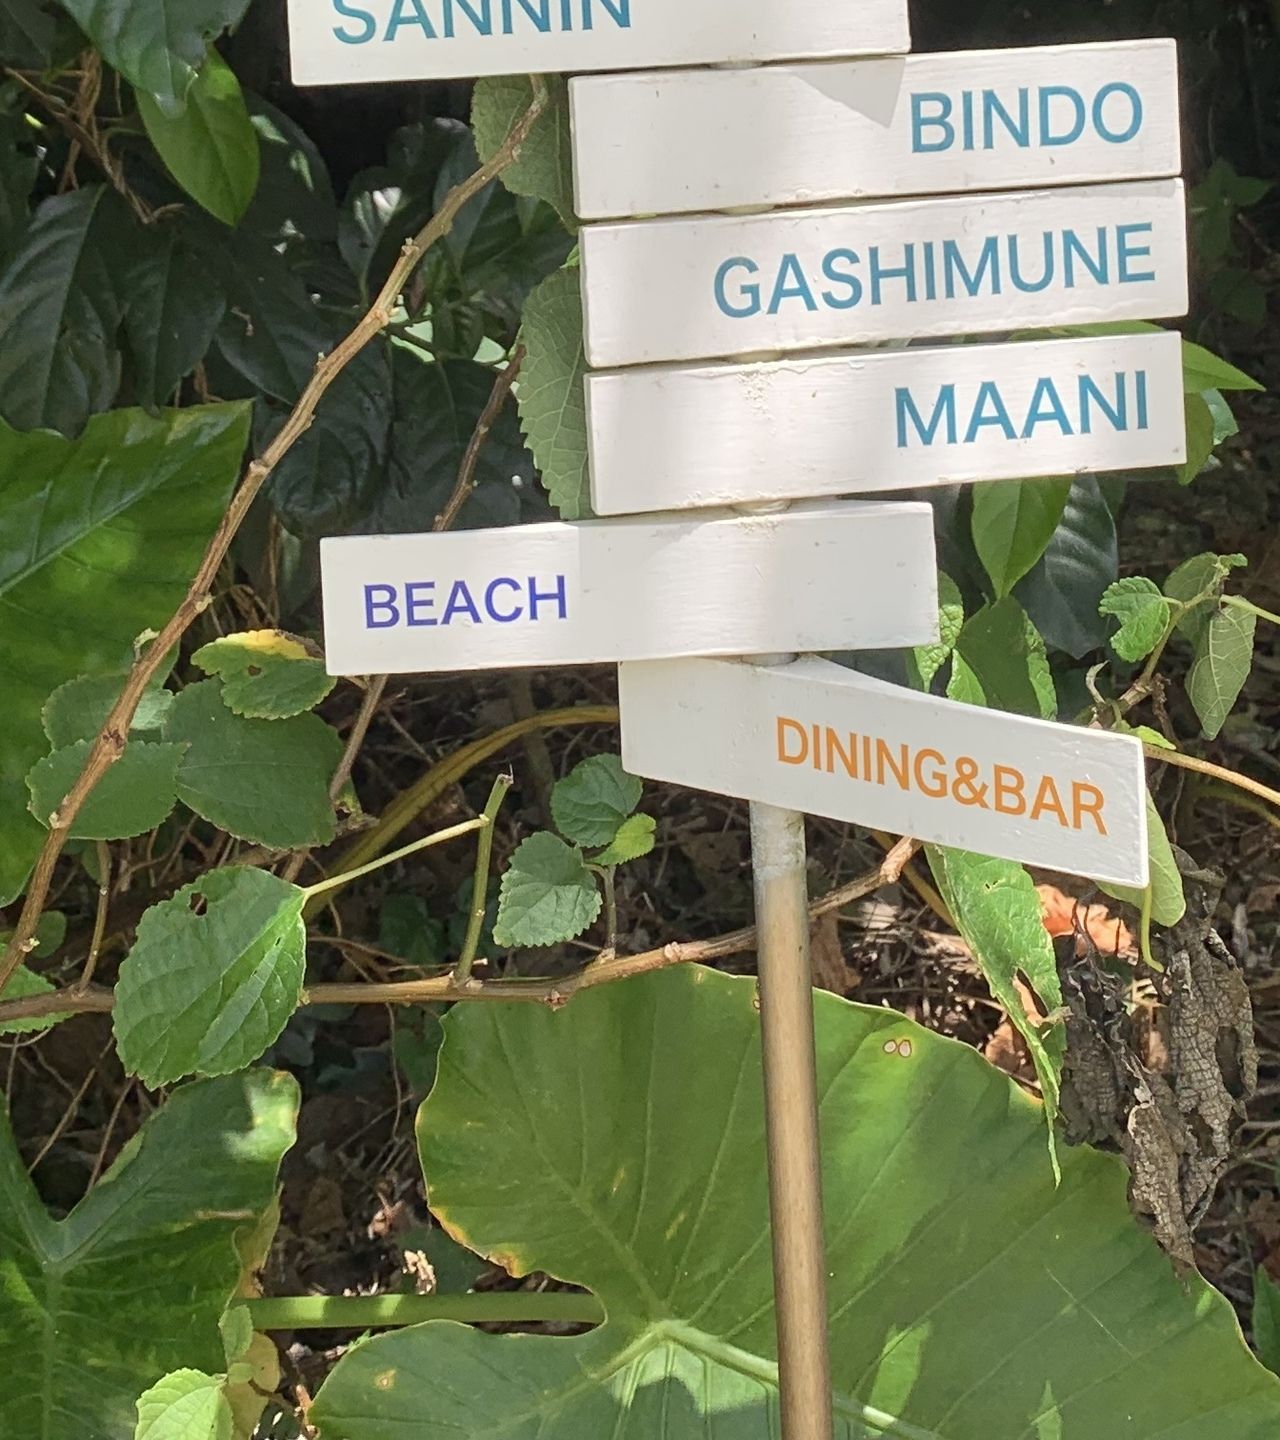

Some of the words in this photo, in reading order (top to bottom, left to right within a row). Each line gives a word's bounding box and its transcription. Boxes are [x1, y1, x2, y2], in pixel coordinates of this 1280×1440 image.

[910, 81, 1144, 153] BINDO
[713, 223, 1156, 318] GASHIMUNE
[894, 371, 1149, 447] MAANI
[363, 574, 568, 629] BEACH
[775, 715, 1108, 837] DINING&BAR
